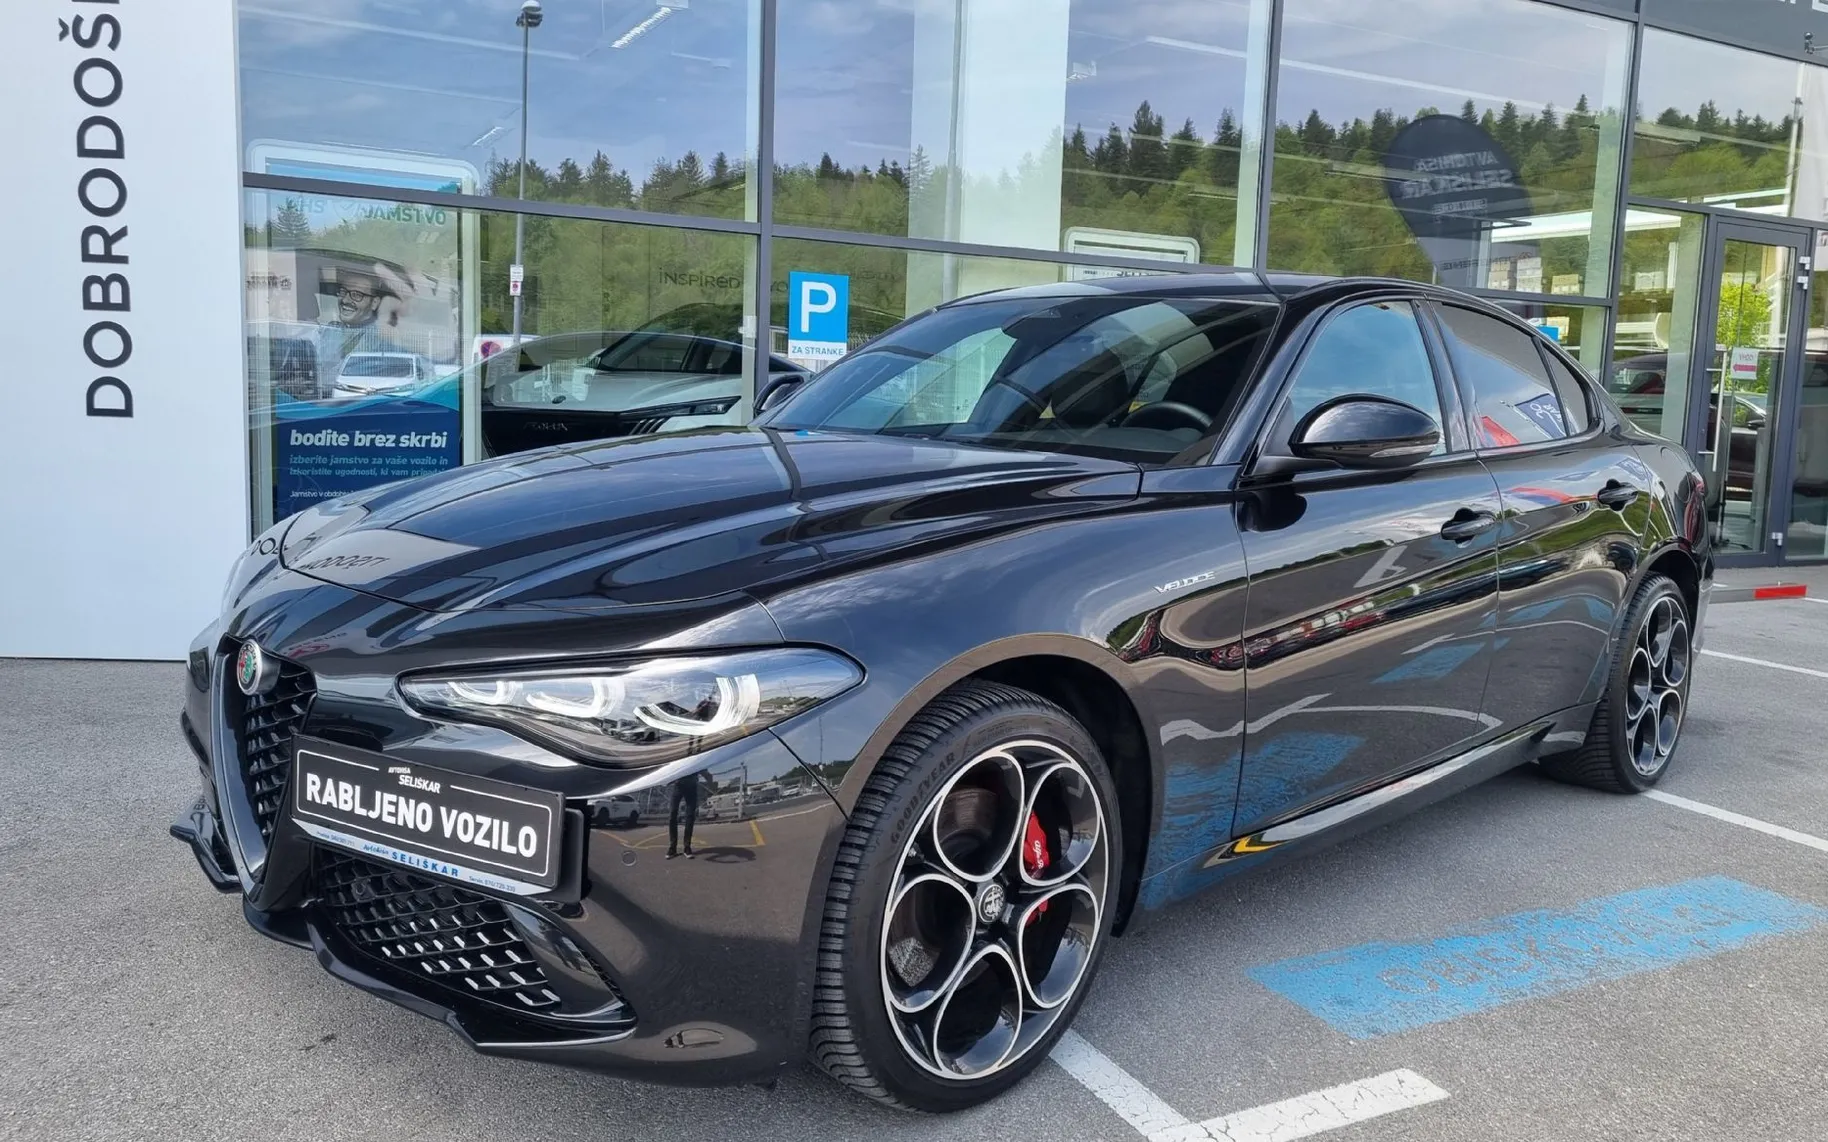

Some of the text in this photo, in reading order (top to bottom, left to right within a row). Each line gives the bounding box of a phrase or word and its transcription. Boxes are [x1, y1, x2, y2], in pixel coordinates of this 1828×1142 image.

[59, 0, 133, 418] DOBRODOŠ
[801, 281, 836, 333] P
[792, 346, 844, 356] ZA STRANKE
[290, 429, 448, 449] bodite brez skrbi
[290, 454, 449, 466] izberite jamstvo za vaše vozilo in
[381, 468, 388, 476] ki
[290, 490, 318, 498] Jamstvo
[398, 774, 441, 794] SELIŠKAR
[306, 772, 537, 858] RABLJENO VOZILO
[392, 850, 459, 877] SELIŠKAR
